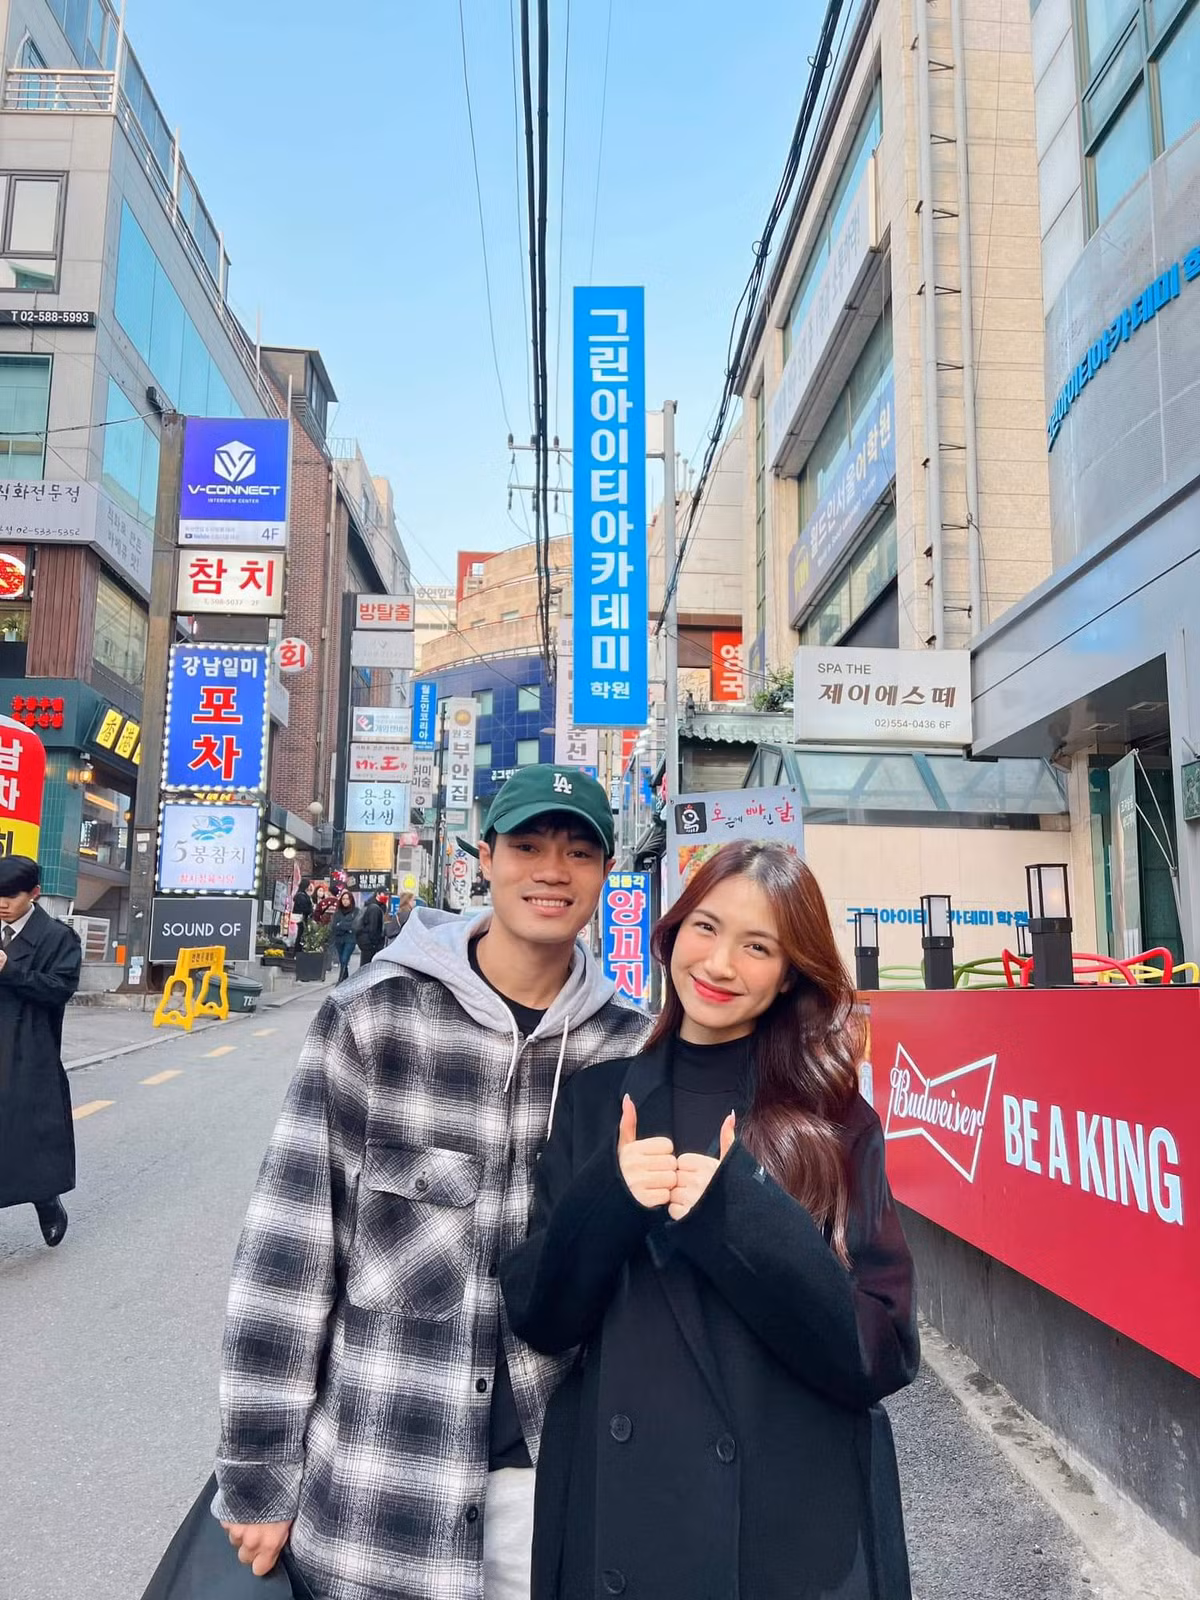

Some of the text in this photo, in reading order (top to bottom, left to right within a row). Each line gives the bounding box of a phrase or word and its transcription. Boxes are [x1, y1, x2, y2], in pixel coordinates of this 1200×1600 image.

[11, 311, 89, 323] T 02-588-5993
[188, 484, 281, 496] V-CONNECT
[588, 308, 634, 672] 그린아이티아카데미
[16, 525, 80, 536] 02-533-5352
[261, 528, 280, 541] 4F
[189, 558, 274, 597] 참치
[359, 603, 411, 622] 방탈출
[279, 640, 307, 668] 회
[181, 656, 258, 679] 강남일미
[818, 663, 871, 675] SPA THE
[590, 681, 630, 699] 학원
[818, 683, 956, 708] 제이에스떼
[874, 718, 951, 729] 02)554-0436 6F
[188, 686, 243, 781] 포차
[451, 742, 470, 803] 부안집
[553, 773, 572, 795] LA
[359, 788, 396, 806] 용용
[359, 808, 395, 826] 선생
[996, 911, 1029, 927] 학원
[161, 923, 242, 937] SOUND OF
[890, 1067, 985, 1137] Budweiser
[1003, 1094, 1183, 1225] BE A KING
